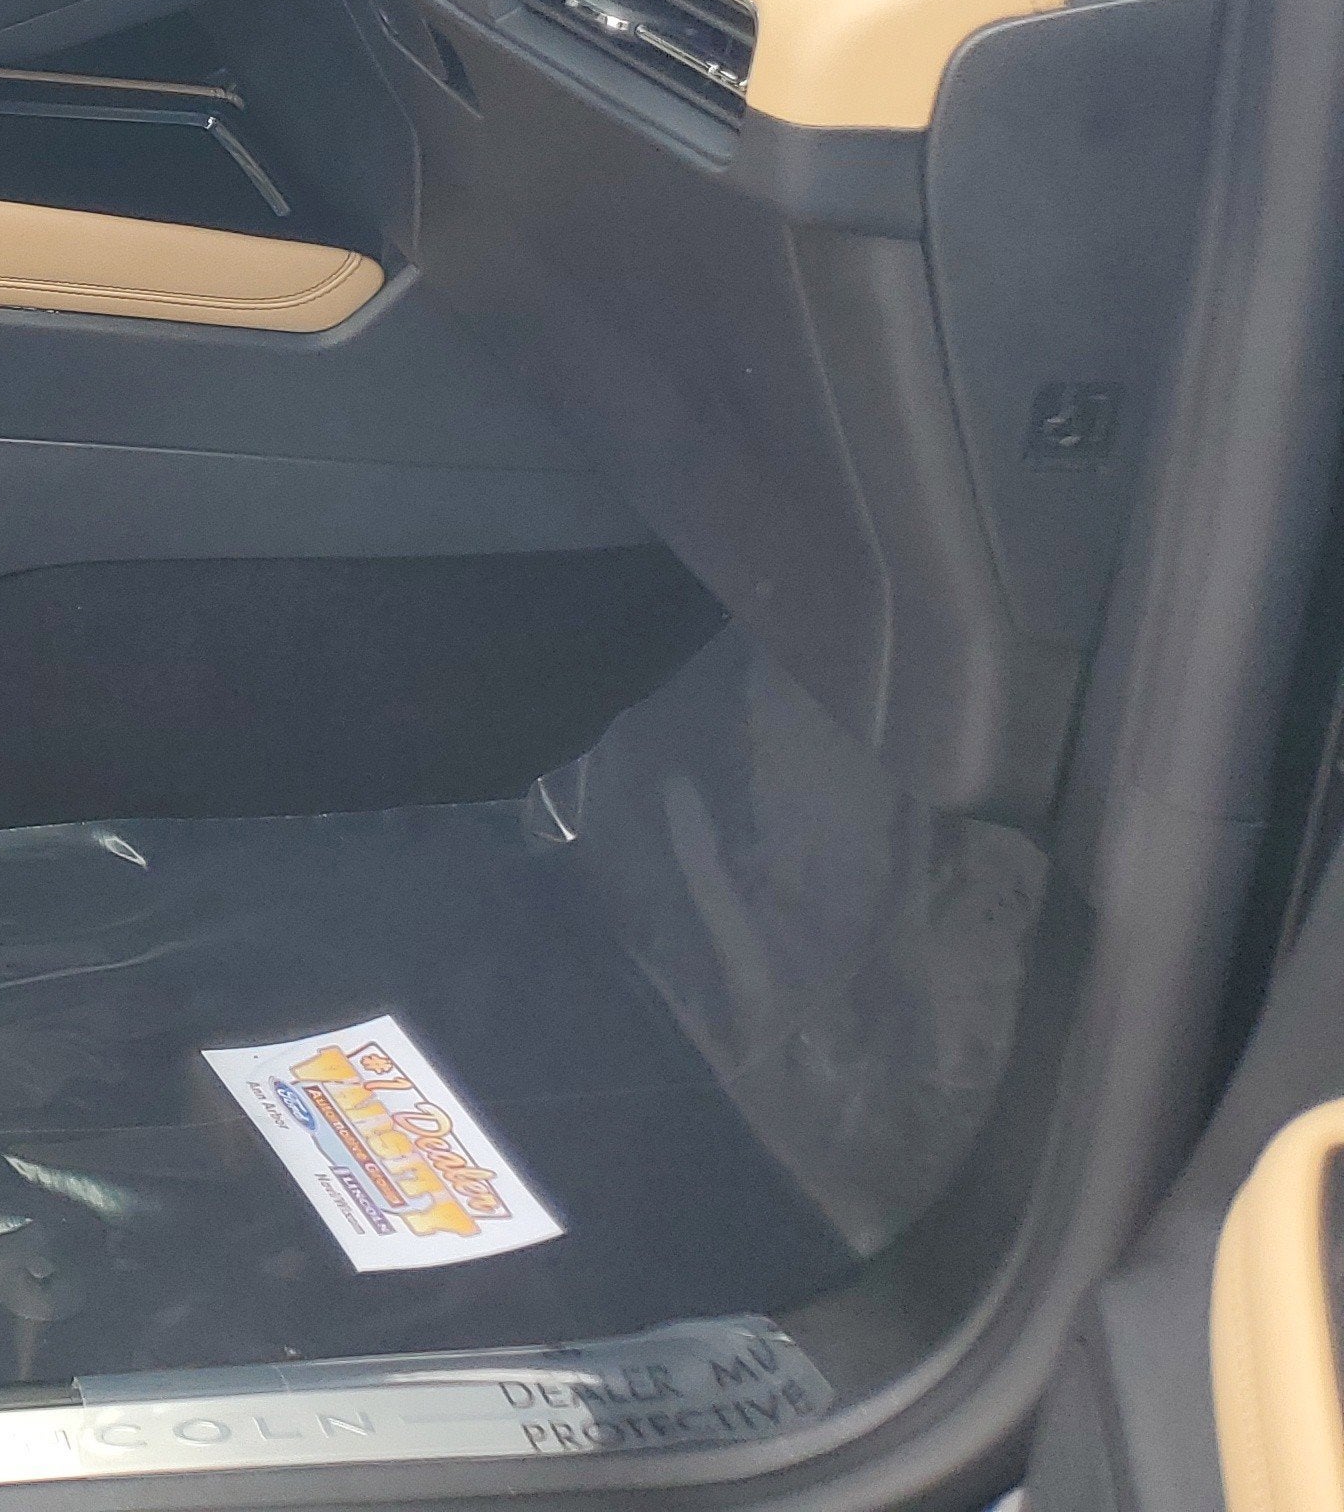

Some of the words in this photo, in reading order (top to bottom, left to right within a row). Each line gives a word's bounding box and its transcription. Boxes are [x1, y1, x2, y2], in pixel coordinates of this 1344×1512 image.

[360, 1053, 413, 1090] #1
[275, 1085, 313, 1126] Ford
[392, 1102, 500, 1212] Dealer
[498, 1364, 683, 1409] DEALER
[520, 1378, 814, 1453] PROTECTIVE
